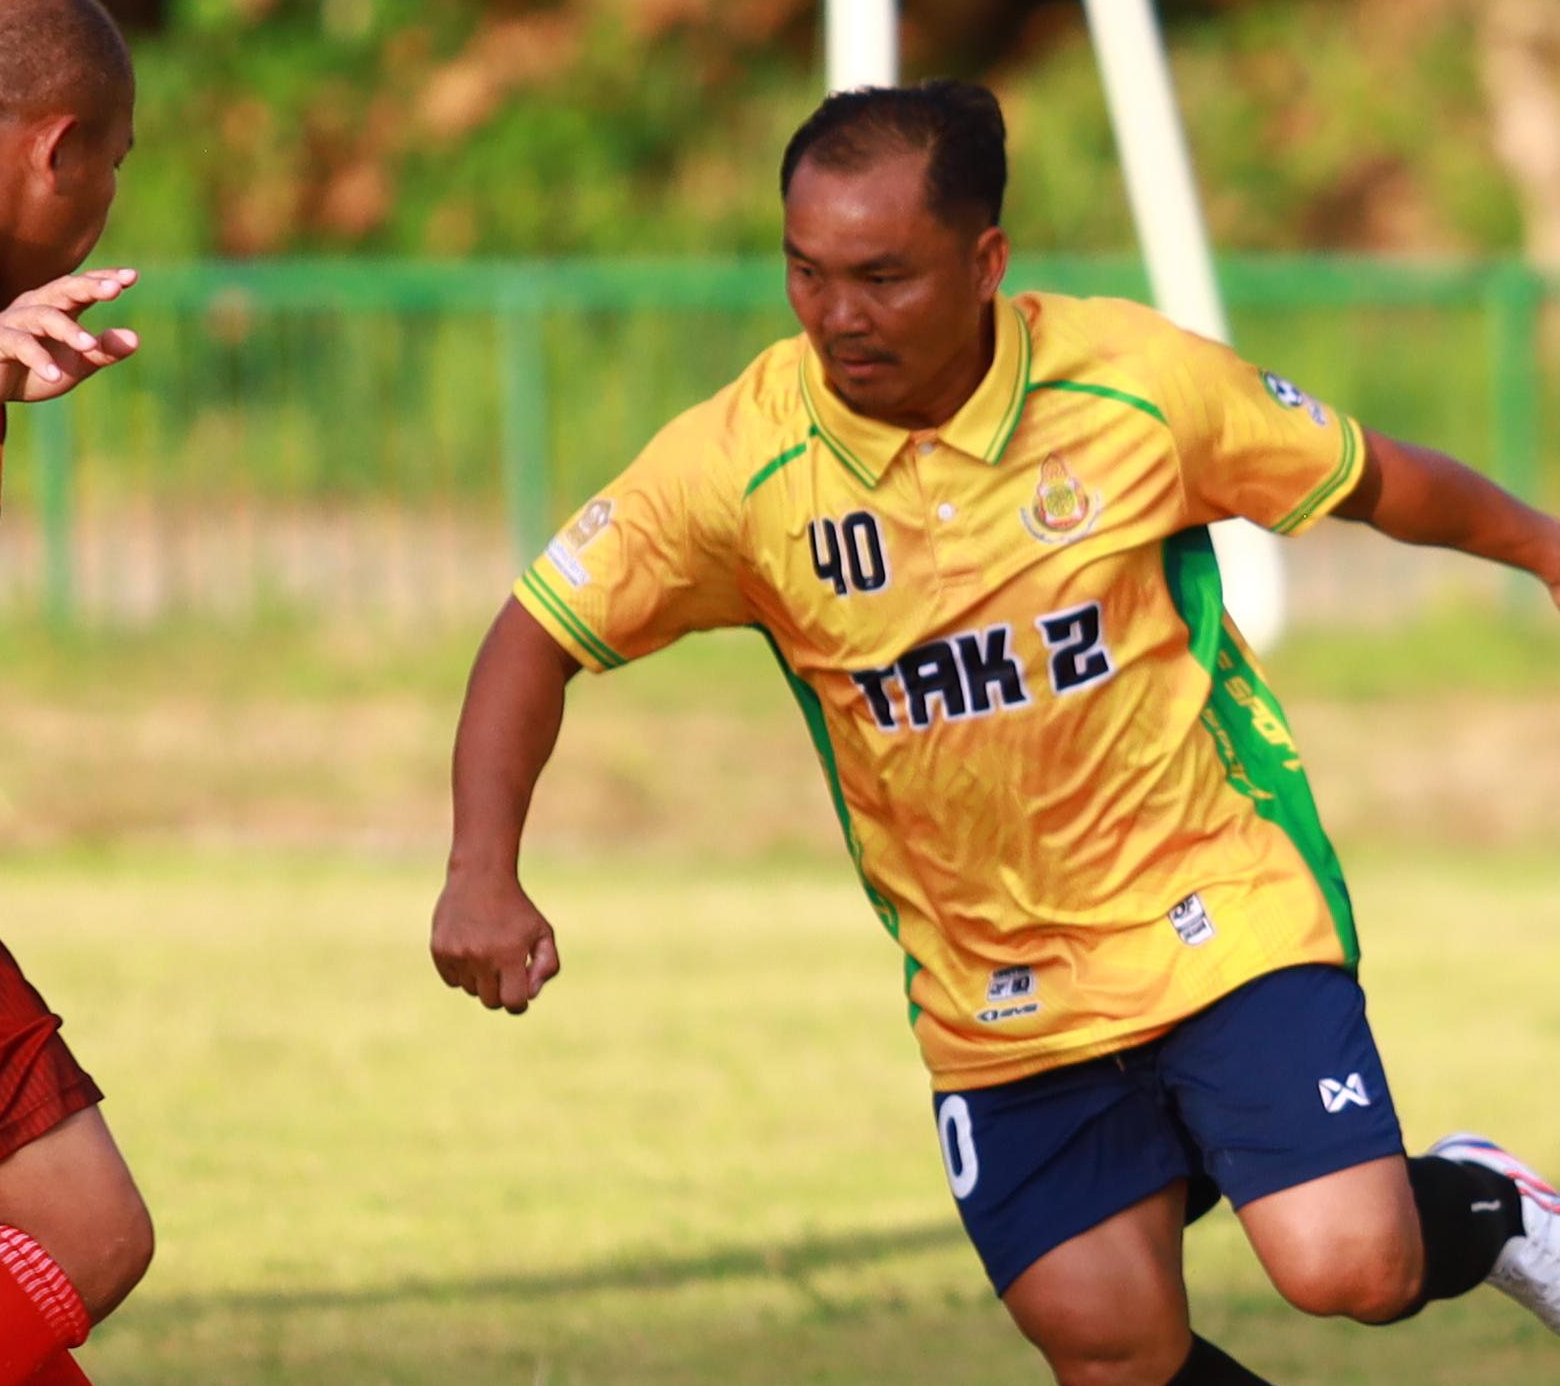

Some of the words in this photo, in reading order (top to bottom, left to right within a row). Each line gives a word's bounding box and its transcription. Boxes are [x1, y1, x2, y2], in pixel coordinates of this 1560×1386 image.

[806, 509, 889, 597] 40
[849, 623, 1030, 731] TAK
[1035, 600, 1115, 693] 2
